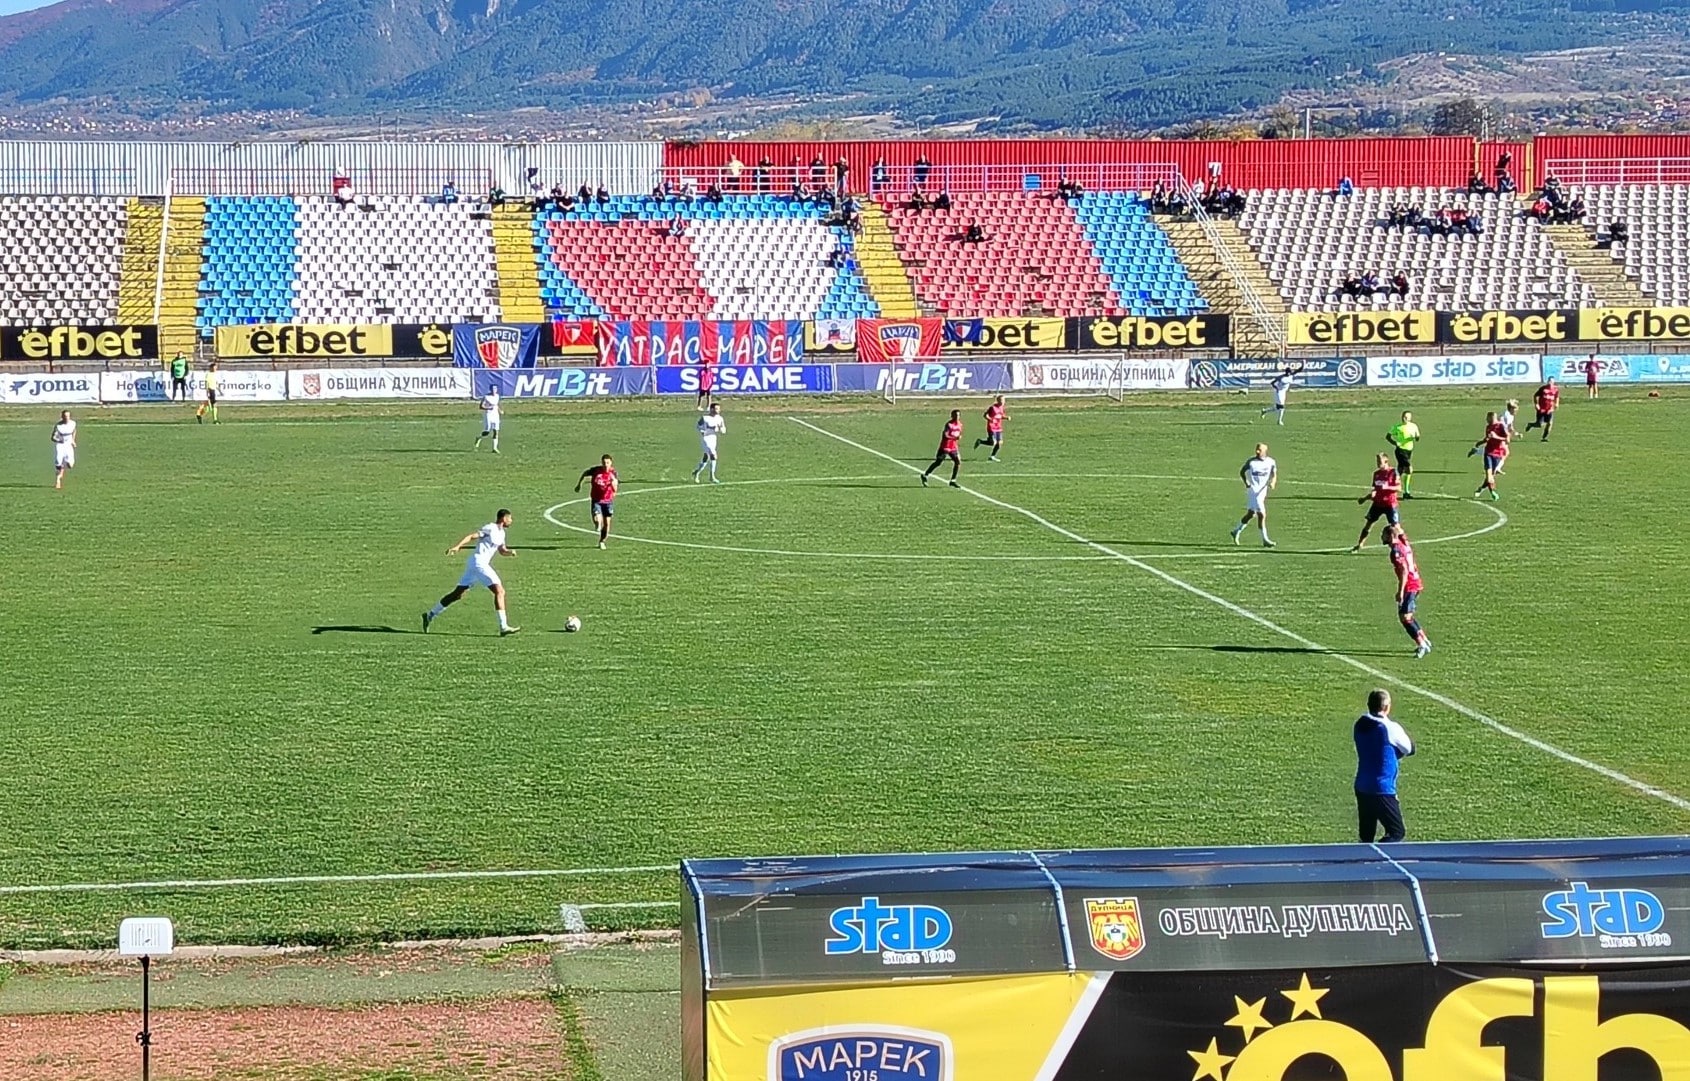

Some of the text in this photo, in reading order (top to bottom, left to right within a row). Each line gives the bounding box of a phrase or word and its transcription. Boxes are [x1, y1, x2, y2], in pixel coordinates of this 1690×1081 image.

[248, 324, 367, 354] efbet
[941, 320, 1040, 347] bet
[1090, 316, 1206, 347] efbet
[1307, 313, 1419, 342] efbet
[1452, 311, 1566, 341] efbet
[21, 326, 142, 358] efbet
[600, 334, 699, 366] УЛТРАС
[716, 333, 801, 365] МАРЕК
[116, 379, 272, 391] Hotel MIGE rimorsko
[327, 375, 457, 391] ОБЩИНА ДУПНИЦА
[514, 368, 612, 397] MrBit
[877, 363, 973, 391] MrBit
[1050, 367, 1107, 382] ОБЩИНА
[1158, 904, 1413, 940] ОБЩИНА ДУПНИЦА
[1599, 932, 1672, 949] Since 1990
[882, 950, 956, 965] Since 1990
[793, 1040, 931, 1079] МАРЕК
